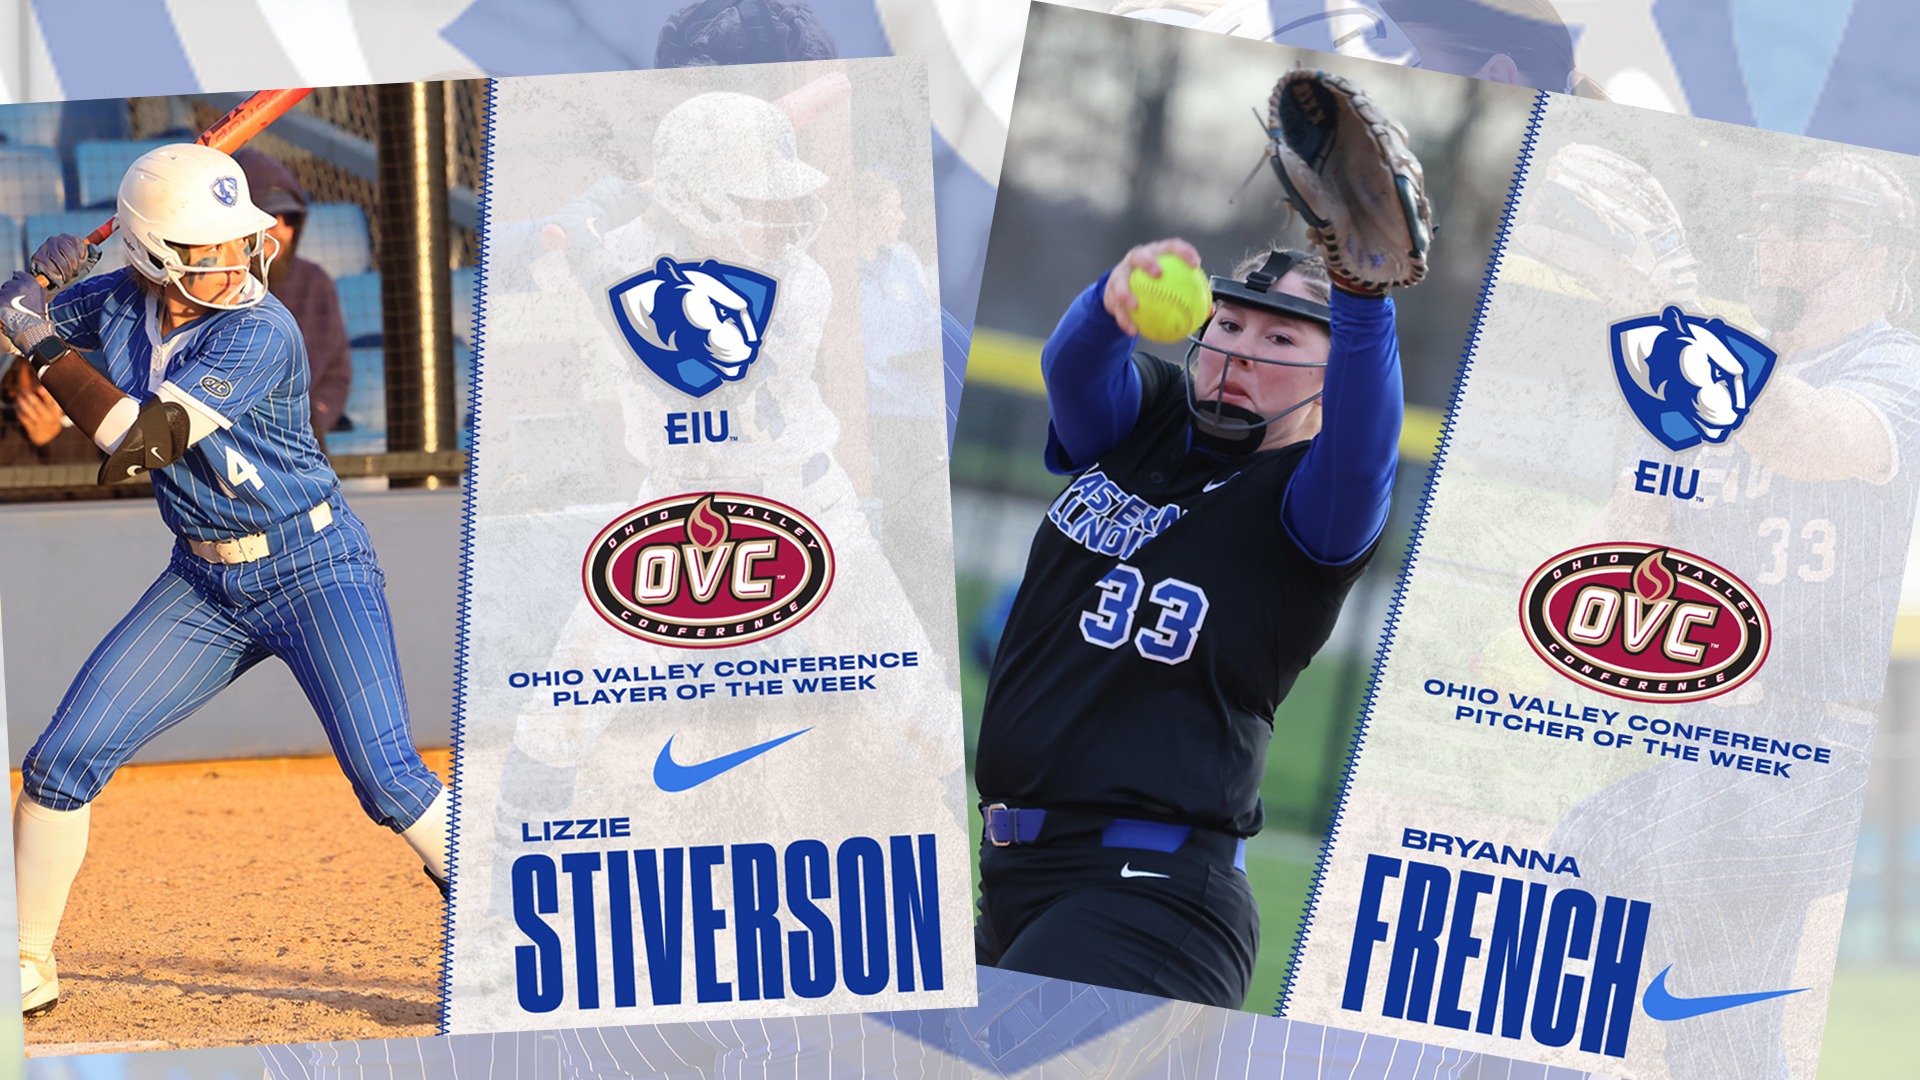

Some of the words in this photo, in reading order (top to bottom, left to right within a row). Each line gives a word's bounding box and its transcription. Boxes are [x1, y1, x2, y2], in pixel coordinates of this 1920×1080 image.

[225, 446, 265, 491] 4
[1757, 517, 1837, 585] 33
[1078, 563, 1210, 665] 33
